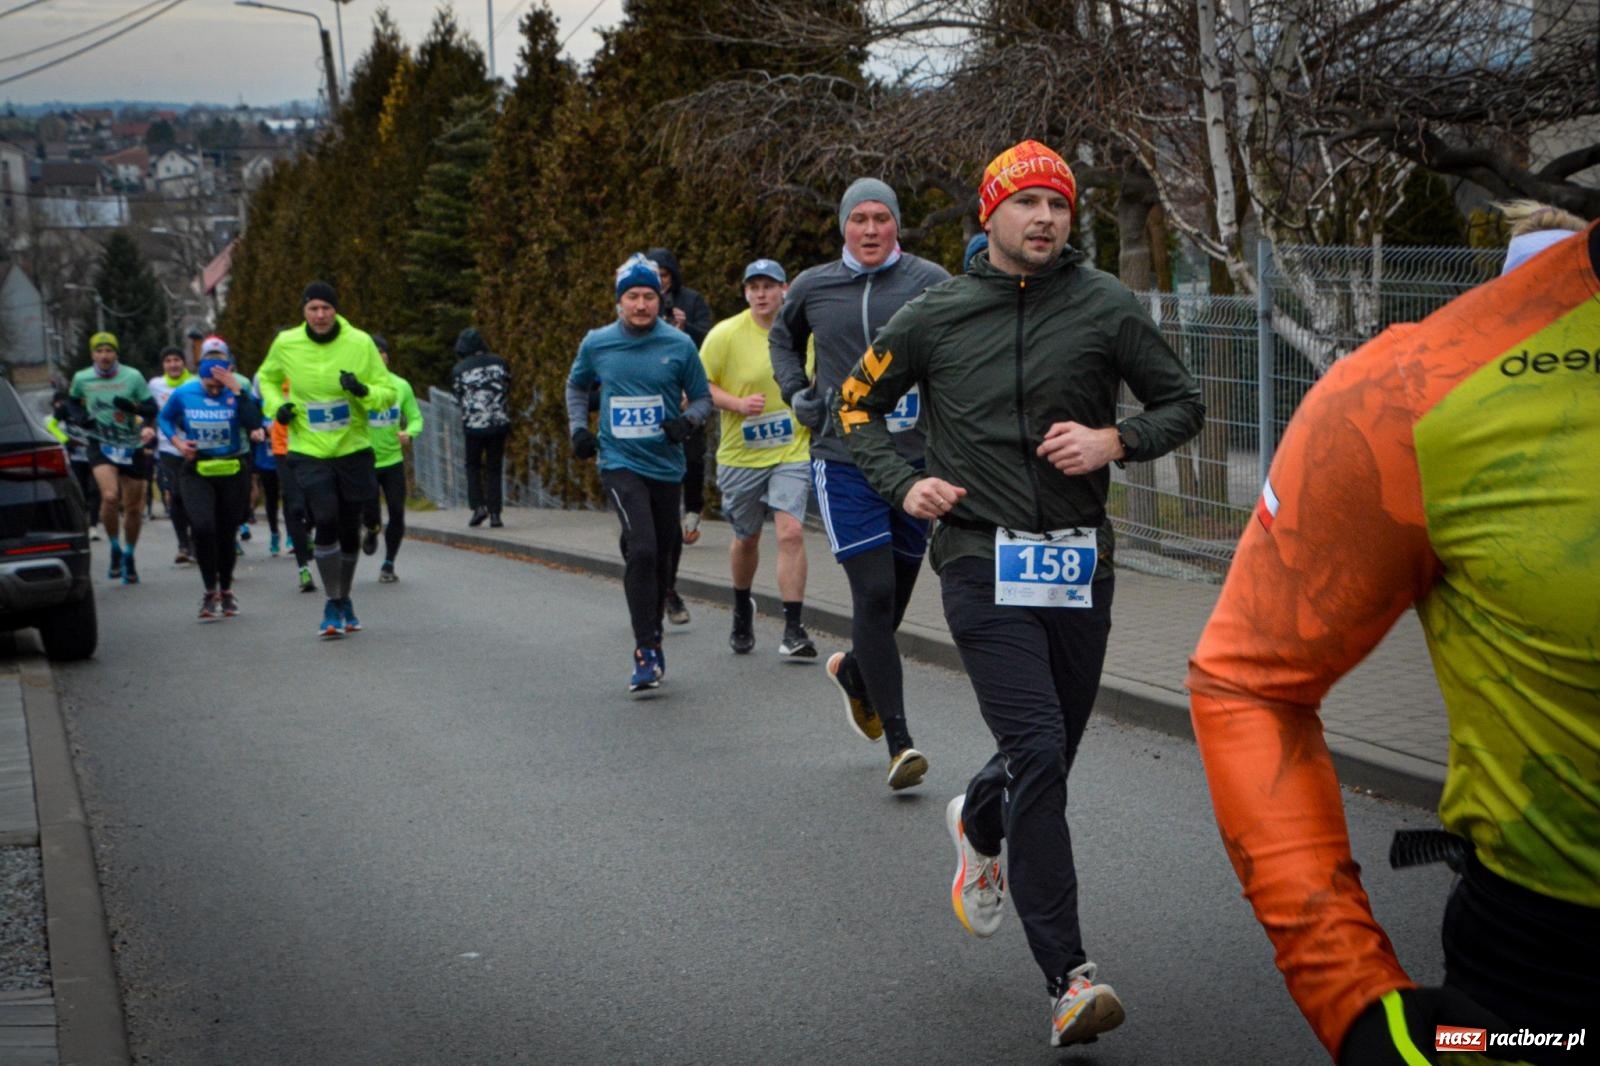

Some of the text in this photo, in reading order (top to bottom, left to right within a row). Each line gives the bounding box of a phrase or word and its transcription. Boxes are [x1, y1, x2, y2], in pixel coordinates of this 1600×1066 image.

[1499, 347, 1600, 377] dee
[323, 408, 334, 423] 5
[619, 408, 656, 426] 213
[197, 428, 224, 441] 125
[752, 421, 785, 440] 115
[1017, 546, 1081, 582] 158
